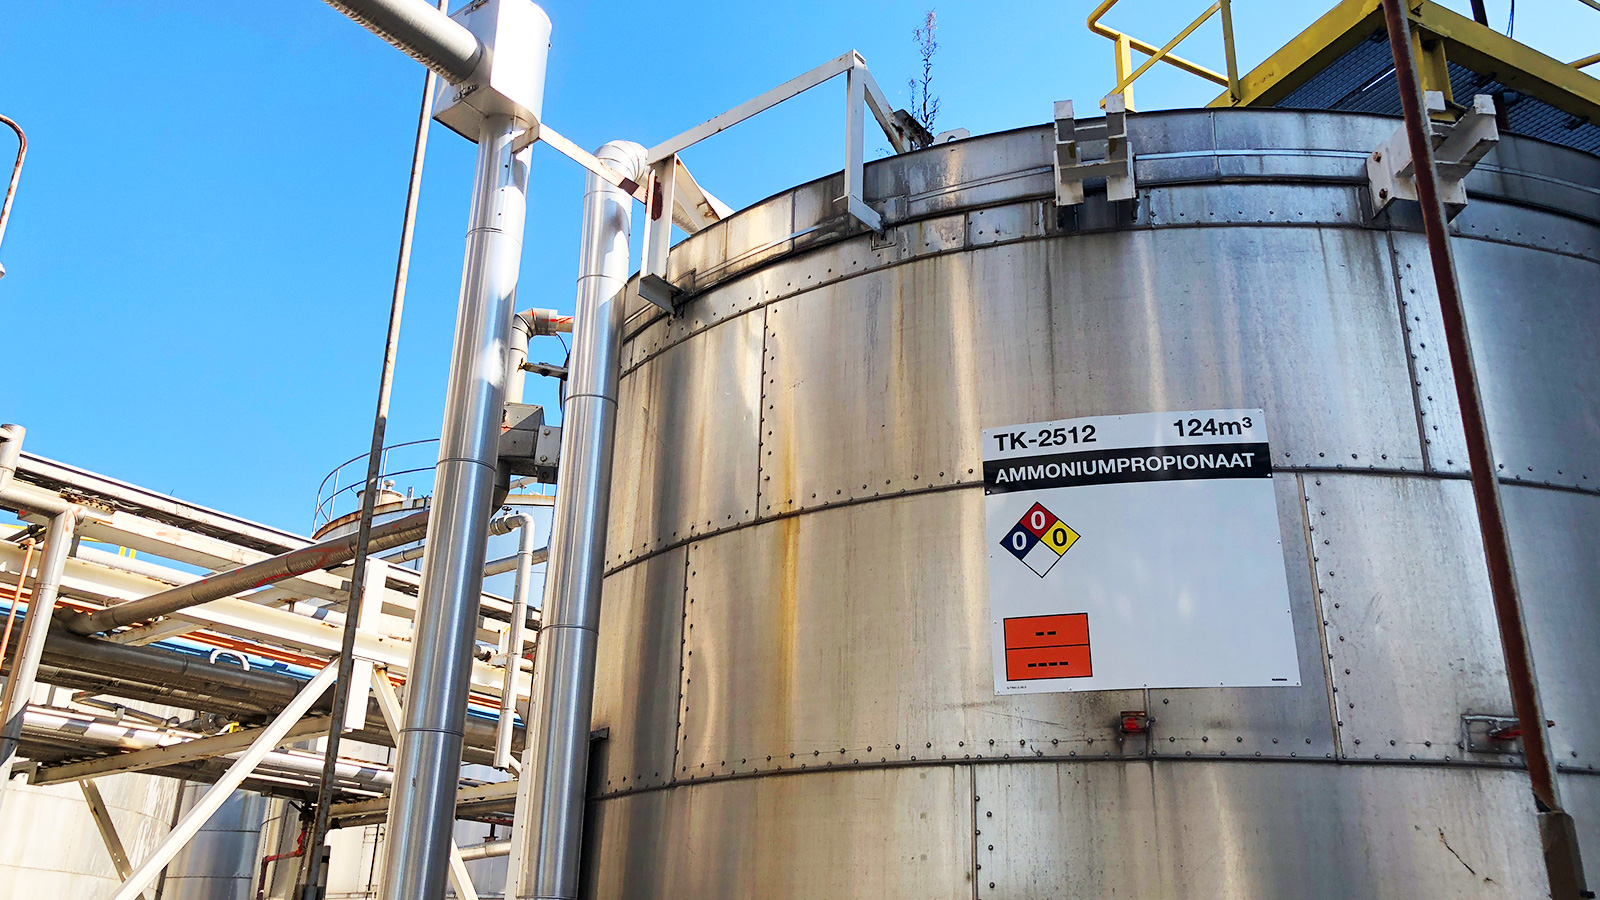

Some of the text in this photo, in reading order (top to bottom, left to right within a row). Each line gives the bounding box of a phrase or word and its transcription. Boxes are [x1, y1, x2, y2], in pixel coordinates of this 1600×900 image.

[993, 425, 1097, 452] TK-2512
[995, 453, 1255, 484] AMMONIUMPROPIONAAT
[1030, 511, 1046, 530] 0
[1012, 531, 1027, 551] 0
[1052, 527, 1068, 547] 0
